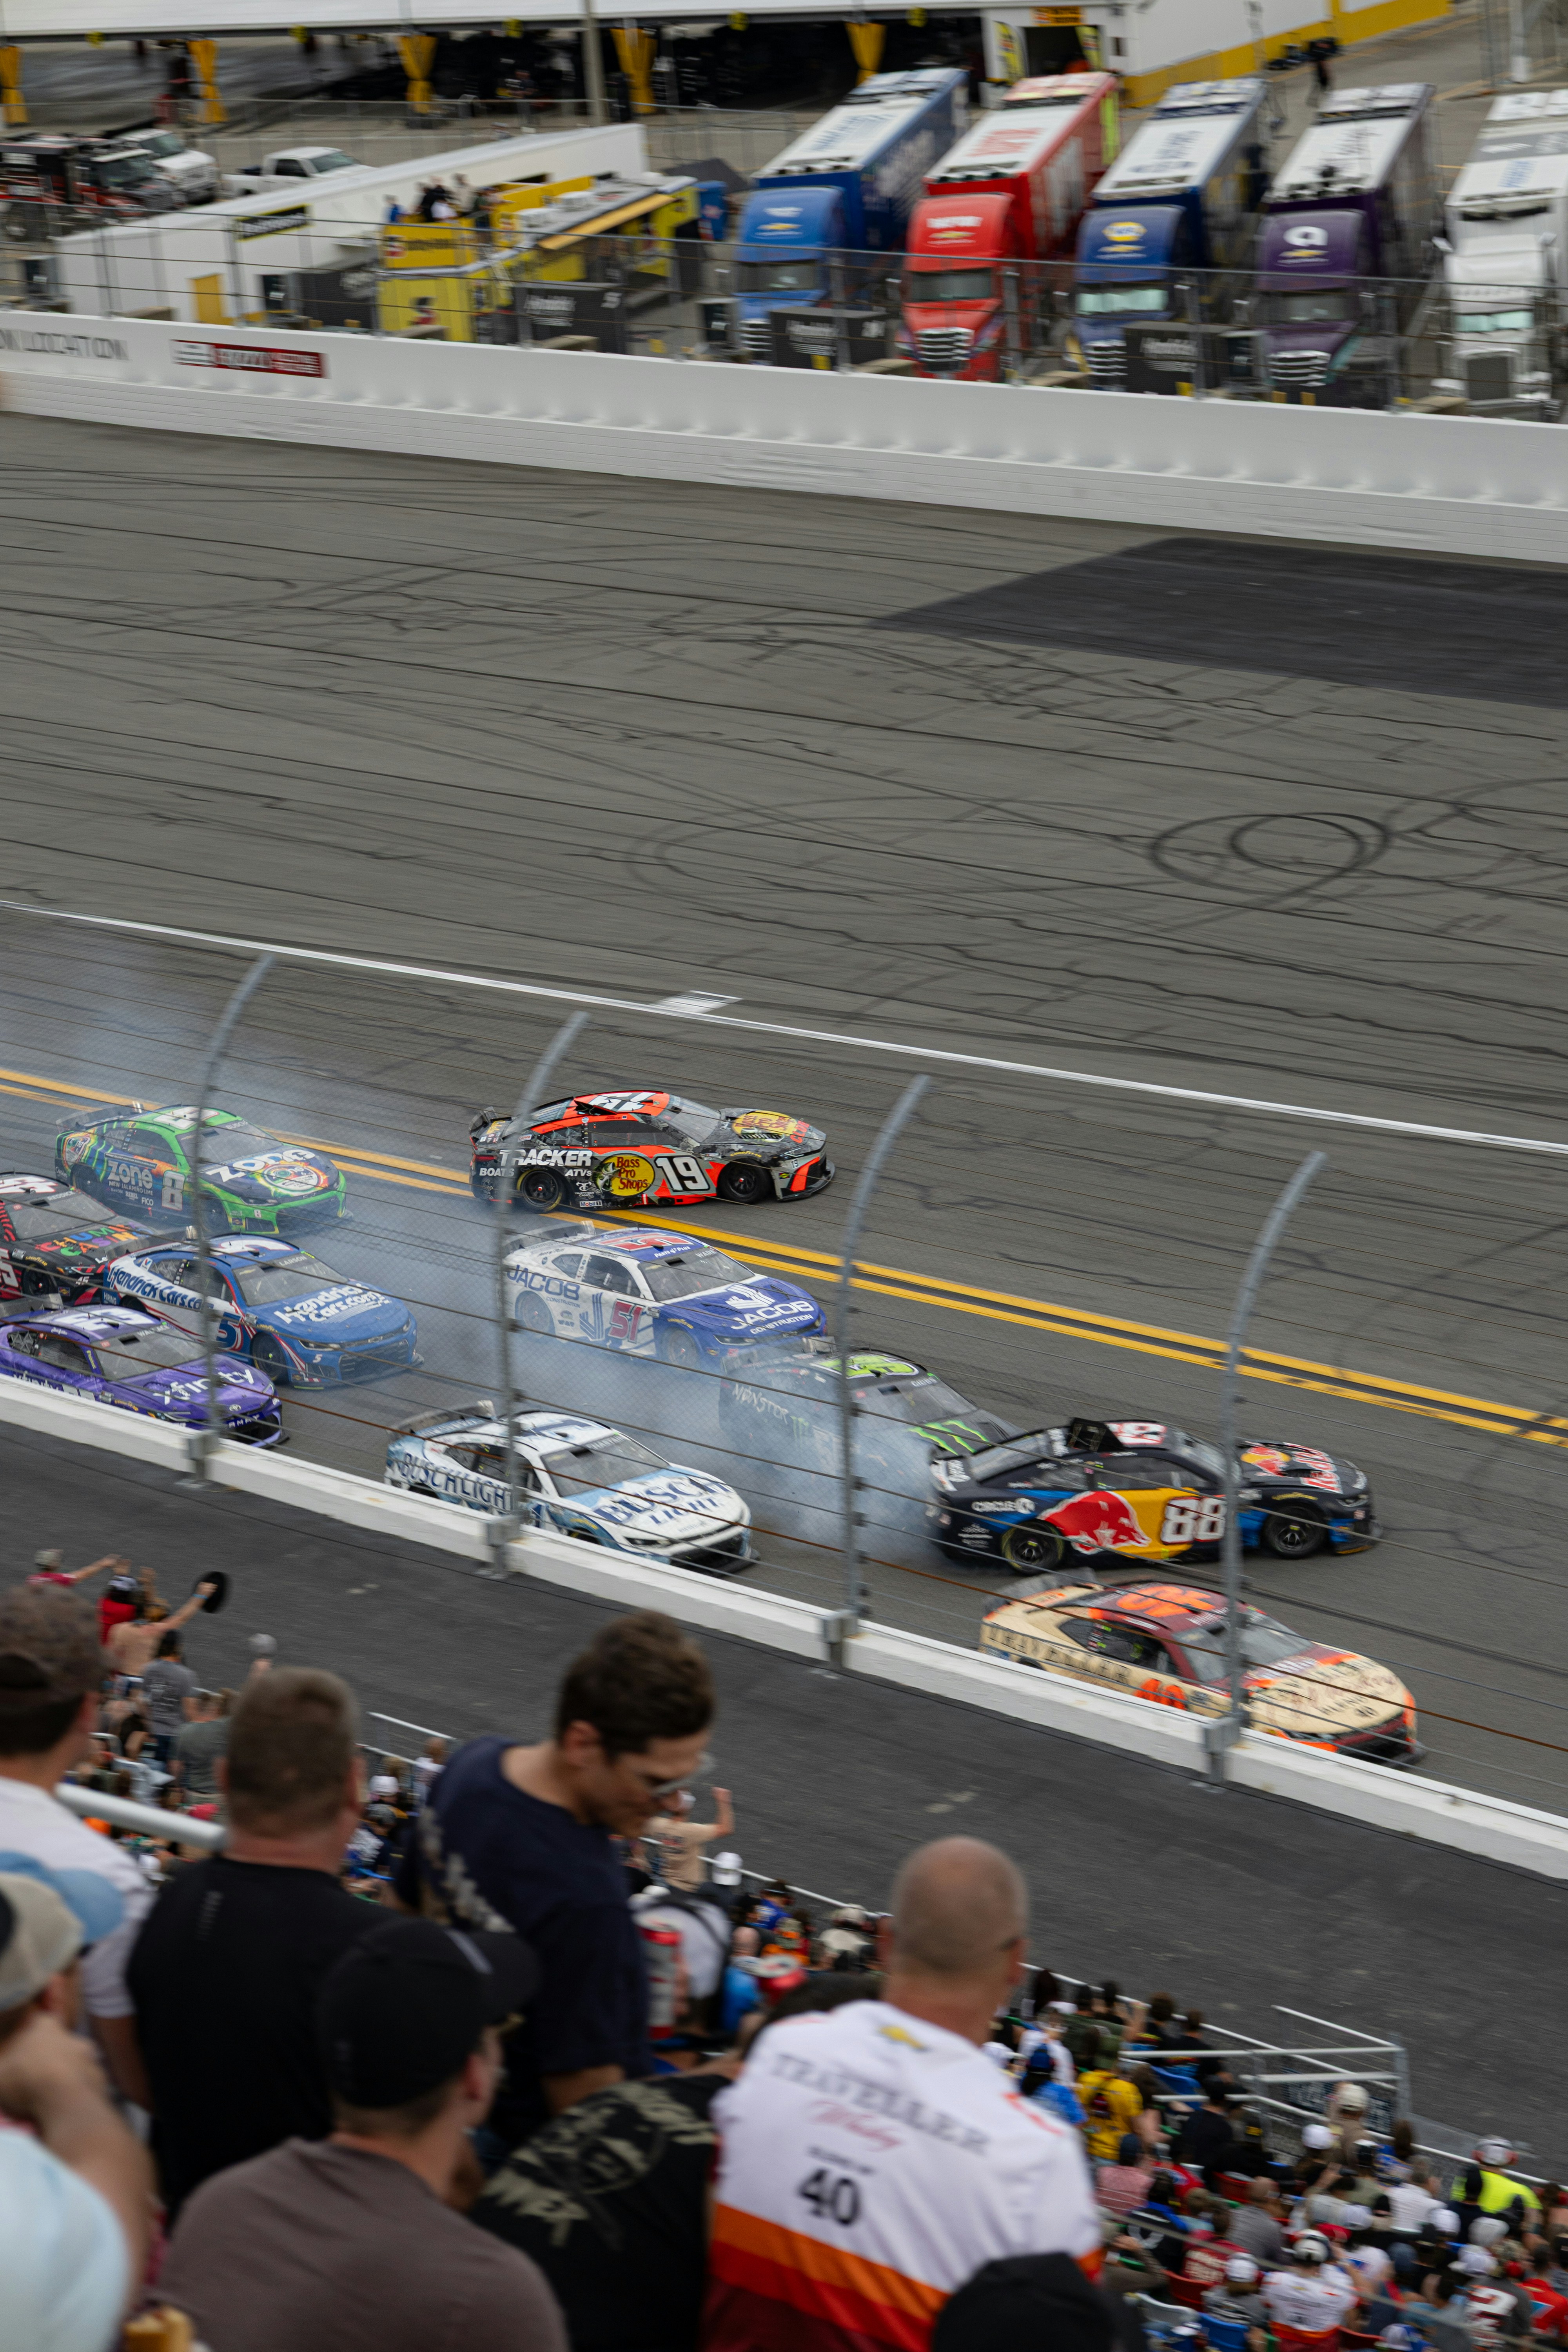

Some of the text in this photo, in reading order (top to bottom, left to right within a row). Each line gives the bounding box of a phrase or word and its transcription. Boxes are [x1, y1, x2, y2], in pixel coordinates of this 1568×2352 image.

[499, 1149, 593, 1166] TRACKER
[617, 1156, 640, 1167] Bass
[618, 1168, 636, 1178] Pro
[619, 1179, 648, 1192] Shops
[654, 1157, 710, 1191] 19
[141, 1197, 154, 1206] FICO
[162, 1171, 185, 1211] 8
[279, 1255, 307, 1266] LARSON
[507, 1265, 581, 1301] JACOB
[546, 1297, 581, 1308] CONSTRUCTION
[730, 1300, 814, 1330] JACOB
[609, 1298, 646, 1348] 51
[750, 1314, 814, 1334] CONSTRUCTION
[152, 1368, 255, 1405] xfinty
[1161, 1496, 1227, 1545] 88
[795, 2168, 862, 2227] 40
